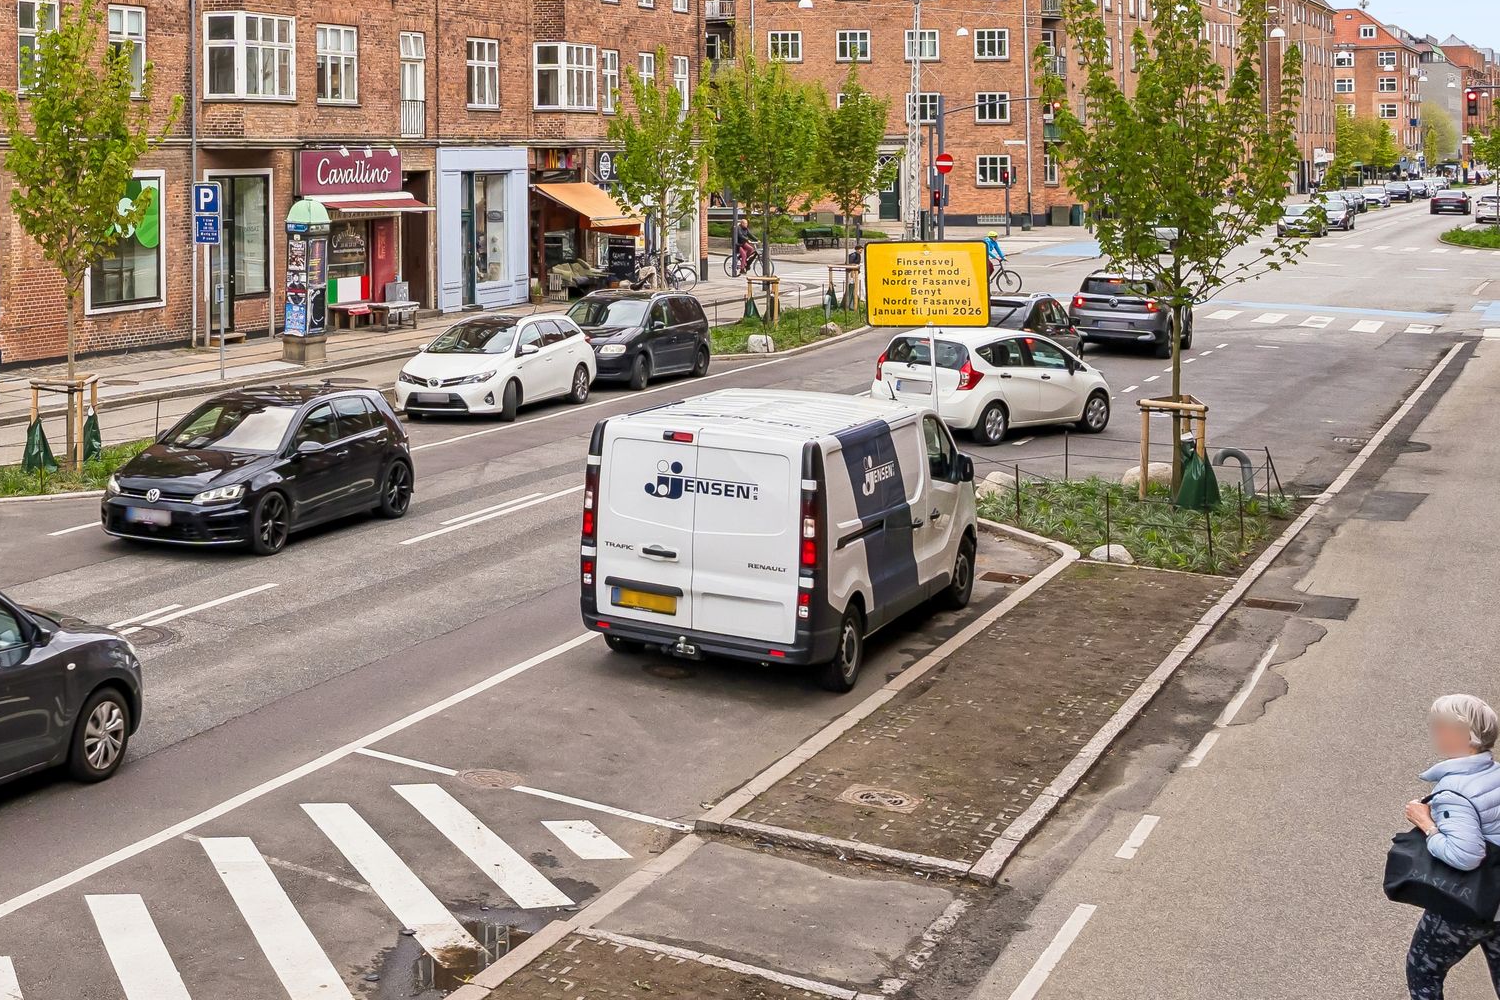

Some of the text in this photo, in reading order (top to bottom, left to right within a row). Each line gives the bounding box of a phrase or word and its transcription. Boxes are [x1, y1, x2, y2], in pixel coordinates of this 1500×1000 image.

[317, 158, 392, 185] Cavallino
[200, 188, 214, 210] P
[896, 258, 954, 267] Finsensvej
[891, 267, 960, 277] spærret mod
[882, 277, 971, 287] Nordre Fasanvej
[910, 287, 942, 297] Benyt
[883, 297, 972, 307] Nordre Fasanvej
[873, 307, 982, 316] Januar til Juni 2026
[604, 541, 634, 551] TRAFIC
[747, 562, 787, 573] RENAULT
